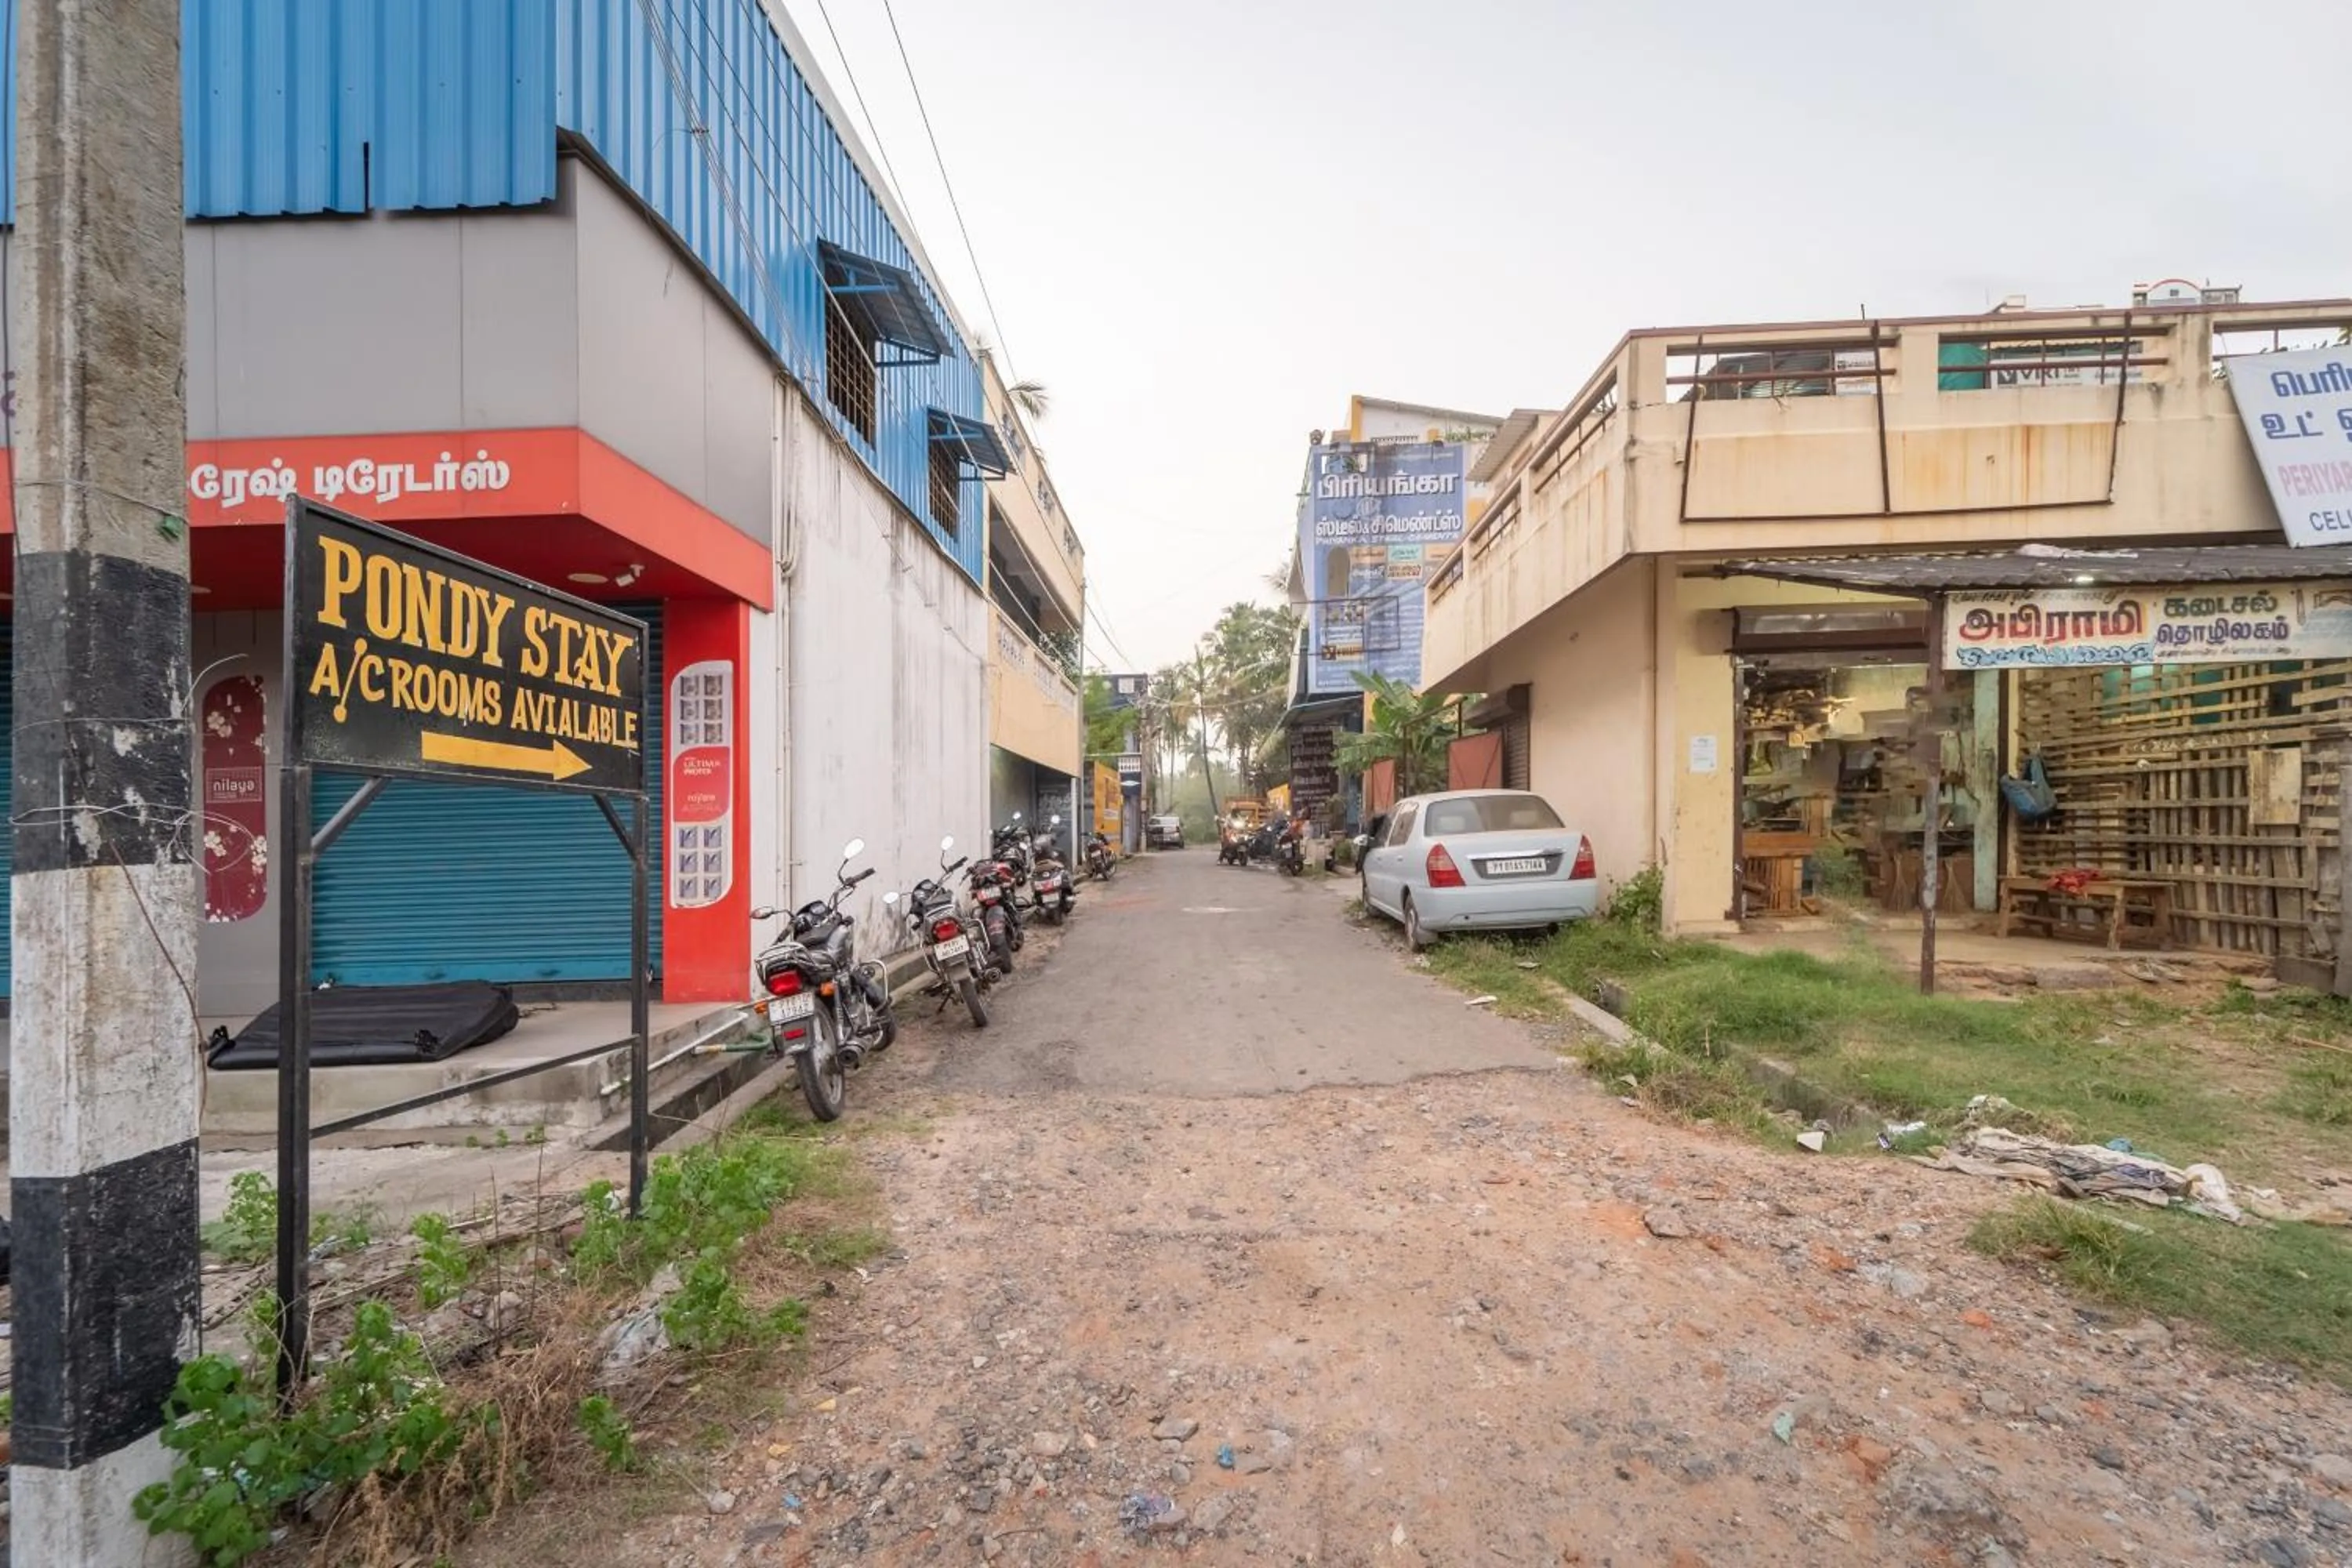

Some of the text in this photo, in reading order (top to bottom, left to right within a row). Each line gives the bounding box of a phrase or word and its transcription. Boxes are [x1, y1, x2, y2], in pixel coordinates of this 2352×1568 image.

[188, 449, 510, 509] ரேஷ் டிரேடர்ஸ்
[1316, 470, 1460, 499] பிரியங்கா
[318, 535, 634, 698] PONDY STAY
[1959, 599, 2143, 644] அபிராமி
[2163, 590, 2278, 618] கடைசல்
[2157, 615, 2290, 645] தொழிலகம்
[389, 657, 503, 726] ROOMS
[510, 685, 641, 750] AVIALABLE
